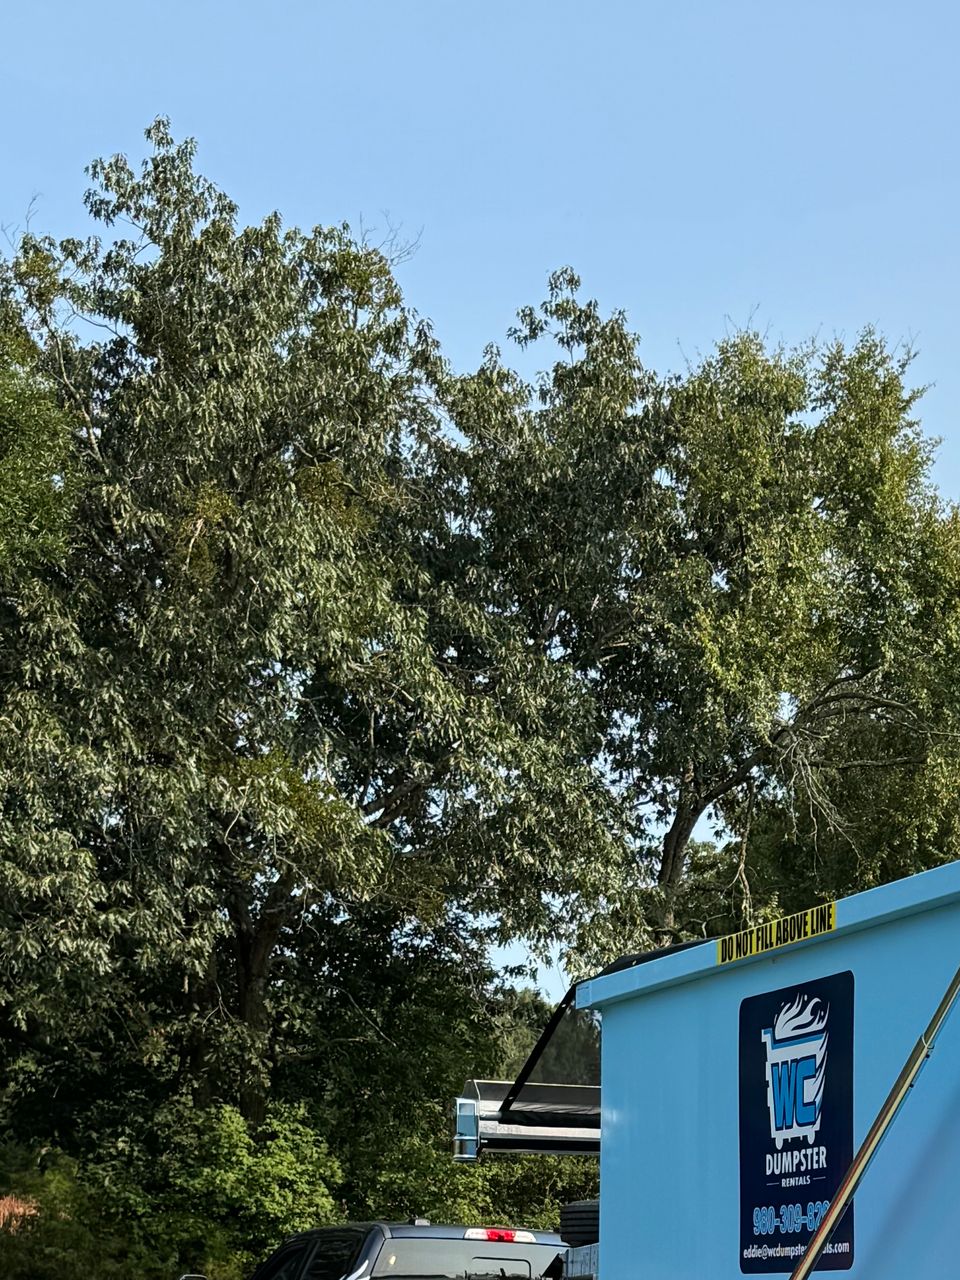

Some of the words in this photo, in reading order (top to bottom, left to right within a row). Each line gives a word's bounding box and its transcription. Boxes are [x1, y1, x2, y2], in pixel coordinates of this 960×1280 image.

[721, 936, 734, 963] DO
[736, 929, 754, 959] NOT
[756, 923, 774, 953] FILL
[776, 911, 808, 947] ABOVE
[811, 902, 832, 936] LINE
[771, 1054, 816, 1131] WC
[765, 1146, 827, 1176] DUMPSTER
[781, 1175, 811, 1188] RENTALS
[753, 1200, 830, 1236] 980-309-82
